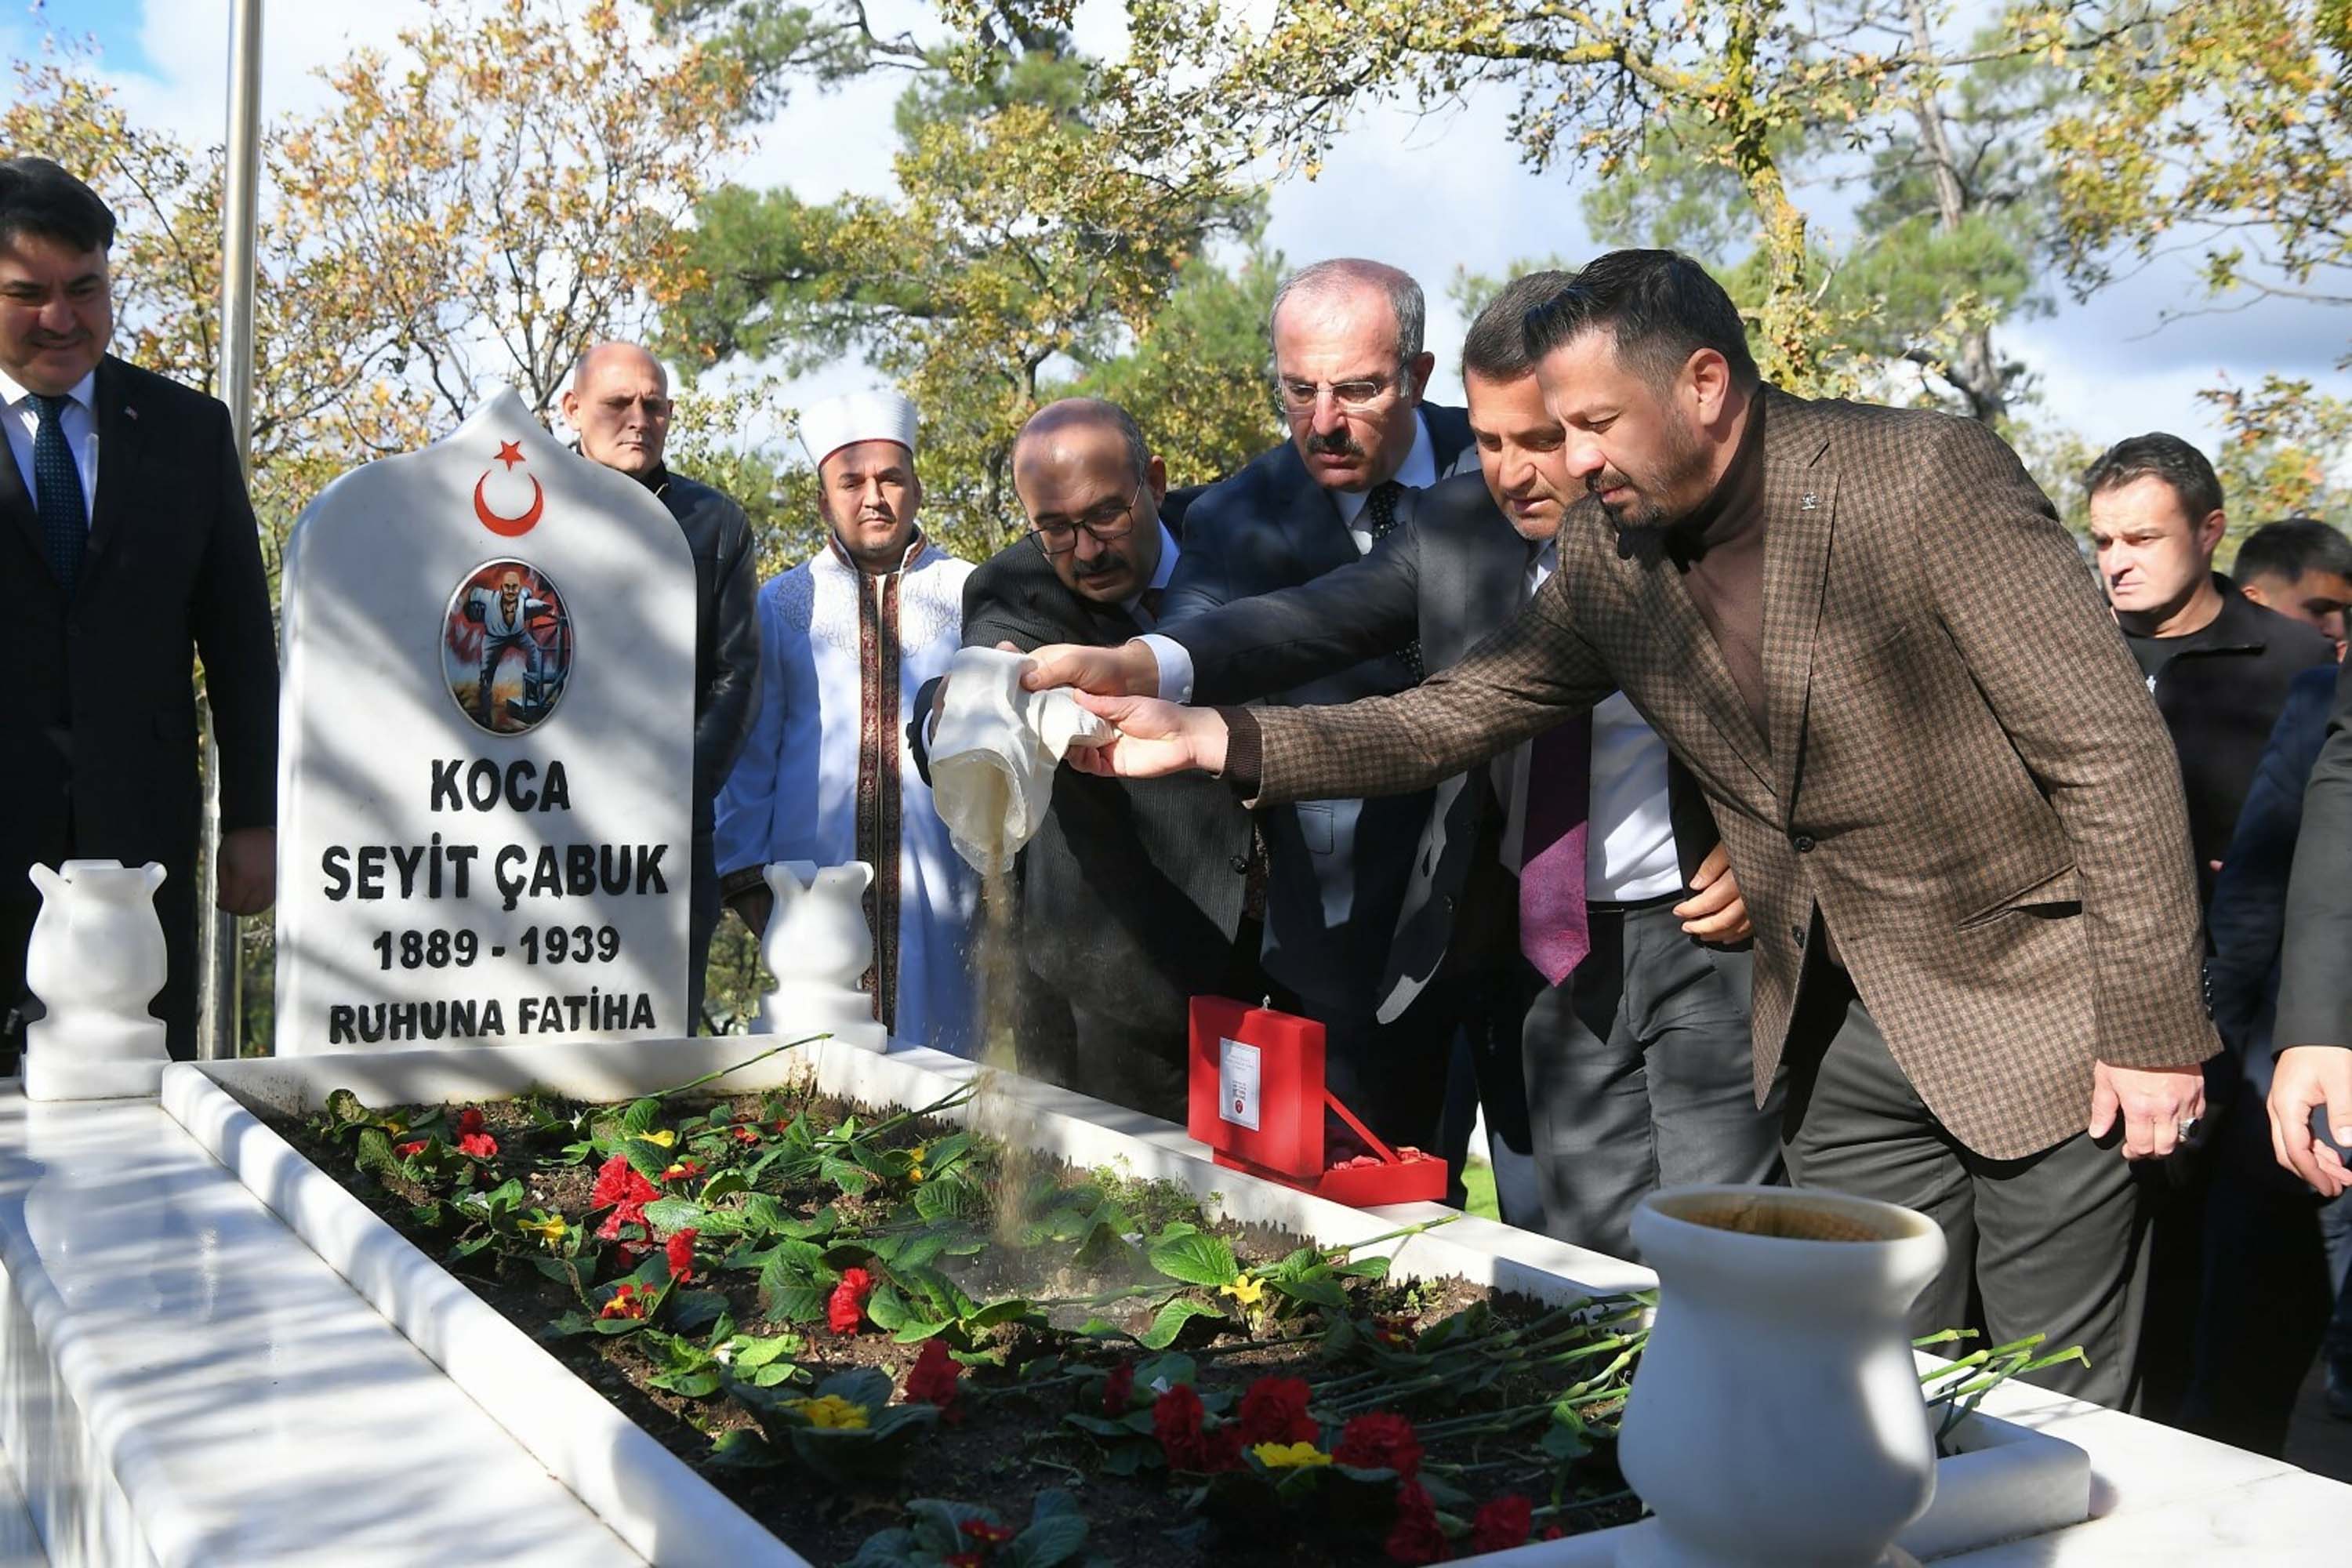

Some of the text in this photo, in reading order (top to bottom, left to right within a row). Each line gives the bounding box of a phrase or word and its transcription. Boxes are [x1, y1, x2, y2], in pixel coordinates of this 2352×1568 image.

[431, 758, 571, 812] KOCA
[322, 832, 669, 911] SEYİT ÇABUK
[373, 926, 621, 971] 1889 - 1939
[329, 986, 656, 1044] RUHUNA FATİHA
